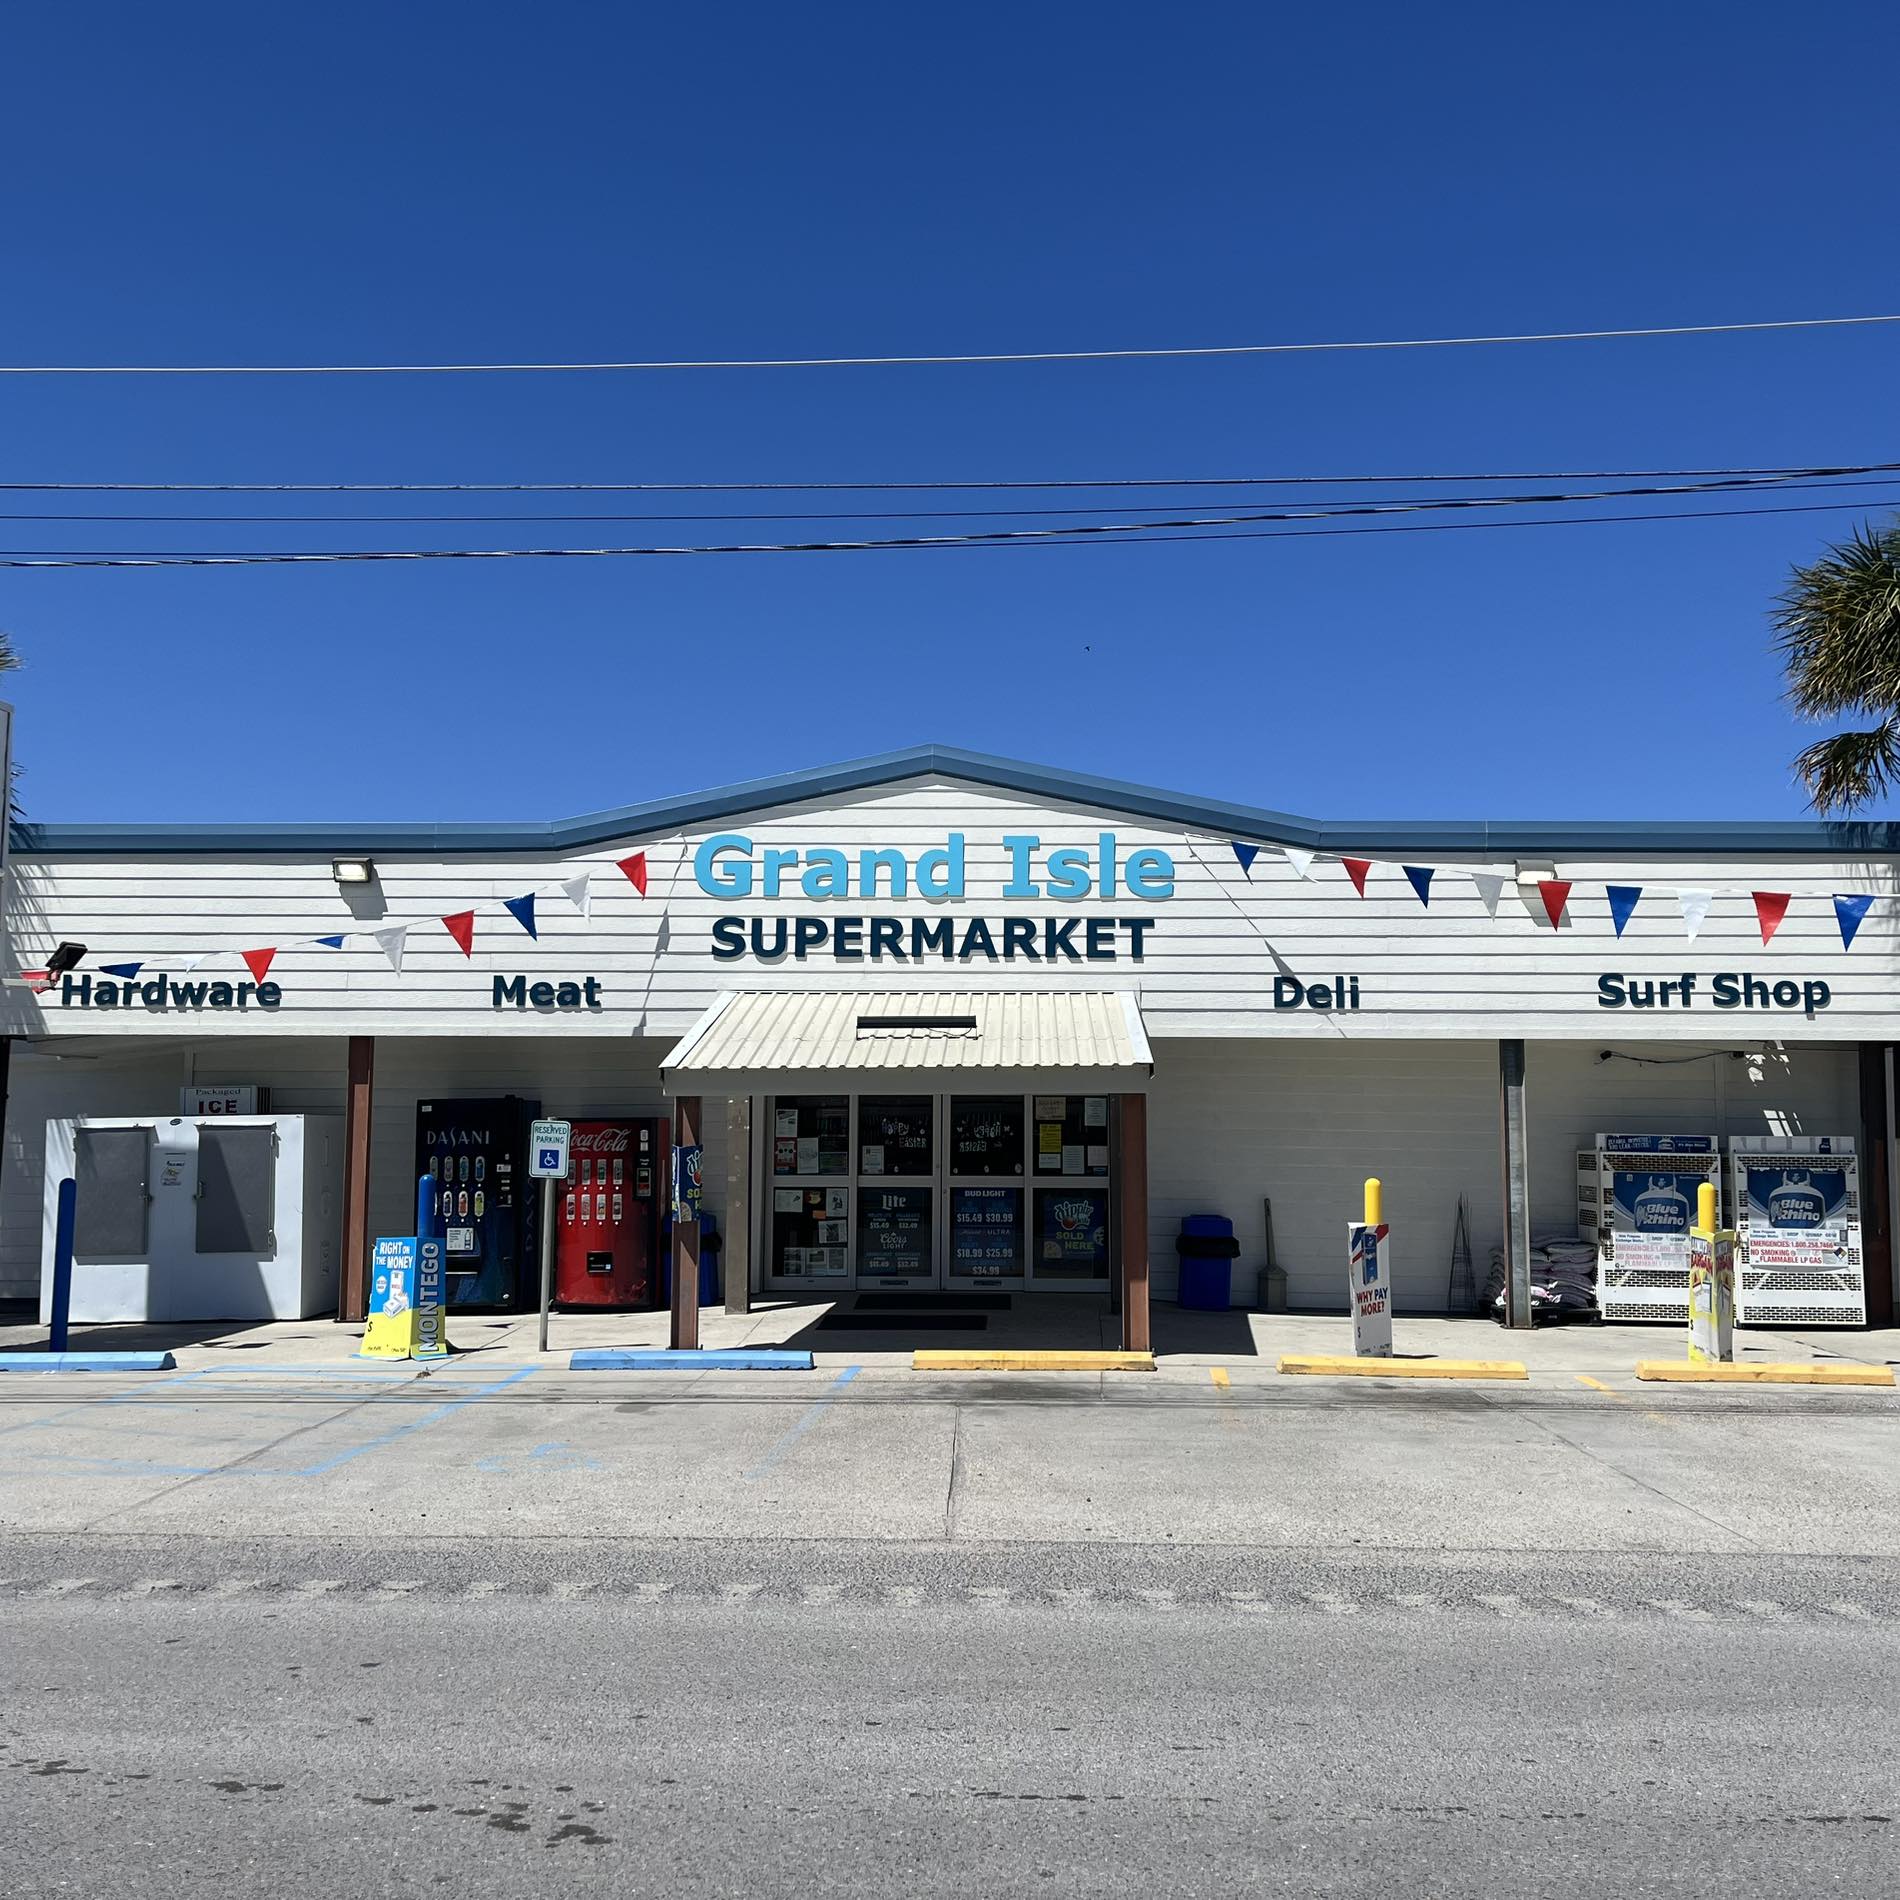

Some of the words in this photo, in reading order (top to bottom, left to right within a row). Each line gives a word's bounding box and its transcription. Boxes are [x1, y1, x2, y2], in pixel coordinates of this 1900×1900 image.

[694, 833, 965, 899] Grand
[1002, 833, 1176, 899] Isle
[710, 917, 1155, 960] SUPERMARKET
[62, 973, 282, 1008] Hardware
[492, 975, 602, 1008] Meat
[1273, 975, 1360, 1010] Deli
[1598, 973, 1697, 1008] Surf
[1711, 973, 1831, 1016] Shop
[198, 1100, 238, 1114] ICE
[535, 1125, 568, 1135] RESERVED
[427, 1128, 489, 1149] DASANI
[536, 1135, 565, 1144] PARKING
[882, 1194, 907, 1211] Lite
[1646, 1203, 1680, 1214] Blue
[1780, 1199, 1814, 1209] Blue
[956, 1213, 983, 1223] $15.49
[985, 1213, 1014, 1223] $30.99
[1643, 1213, 1685, 1226] Rhino
[1777, 1209, 1821, 1222] Rhino
[1055, 1231, 1084, 1240] SOLD
[380, 1241, 403, 1255] RIGHT
[1064, 1241, 1096, 1250] HERE
[985, 1248, 1013, 1258] $25.99
[1759, 1255, 1799, 1264] FLAMMABLE
[1760, 1249, 1790, 1257] SMOKING
[376, 1256, 387, 1265] THE
[386, 1256, 413, 1269] MONEY
[418, 1242, 439, 1353] MONTEGO
[1356, 1290, 1374, 1304] WHY
[1374, 1287, 1388, 1301] PAY
[1360, 1301, 1385, 1317] MORE?
